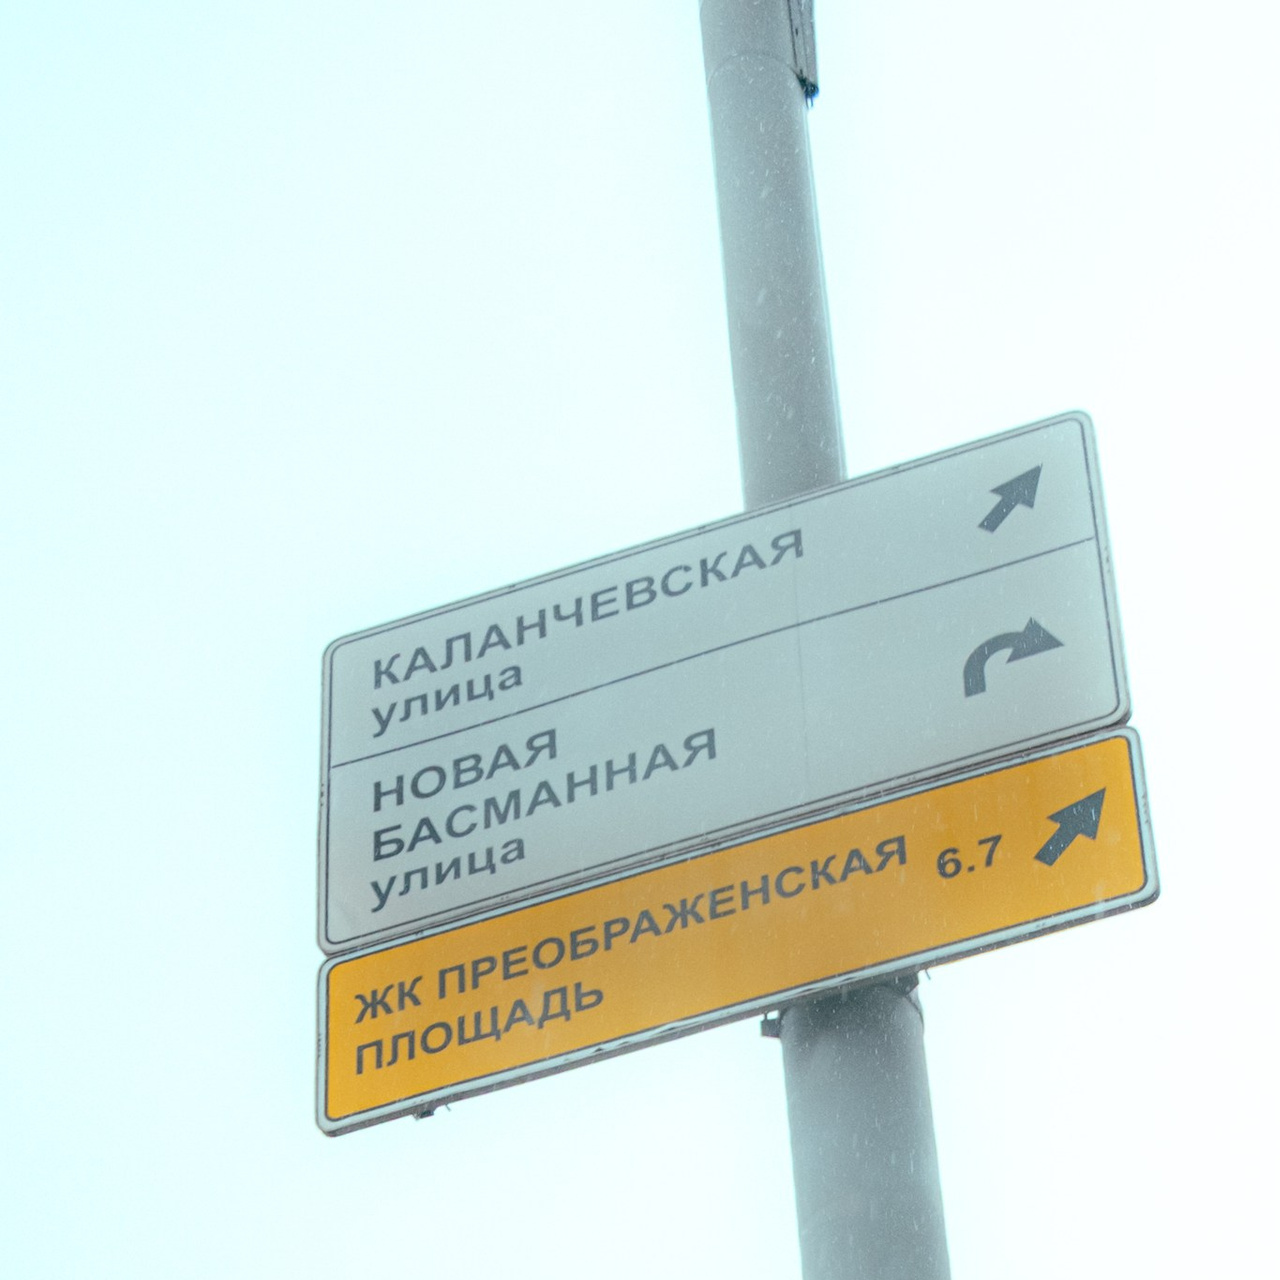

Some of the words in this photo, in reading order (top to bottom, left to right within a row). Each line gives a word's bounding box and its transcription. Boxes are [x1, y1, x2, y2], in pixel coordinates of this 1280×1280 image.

[373, 528, 804, 690] КАЛАНЧЕВСКАЯ
[371, 665, 523, 739] улица
[372, 727, 718, 863] БАСМАННАЯ
[373, 728, 558, 813] НОВАЯ
[370, 838, 526, 914] улица
[354, 975, 424, 1024] ЖК
[437, 834, 907, 1000] ПРЕОБРАЖЕНСКАЯ
[936, 833, 1003, 879] 6.7
[355, 981, 604, 1075] ПЛОЩАДЬ
